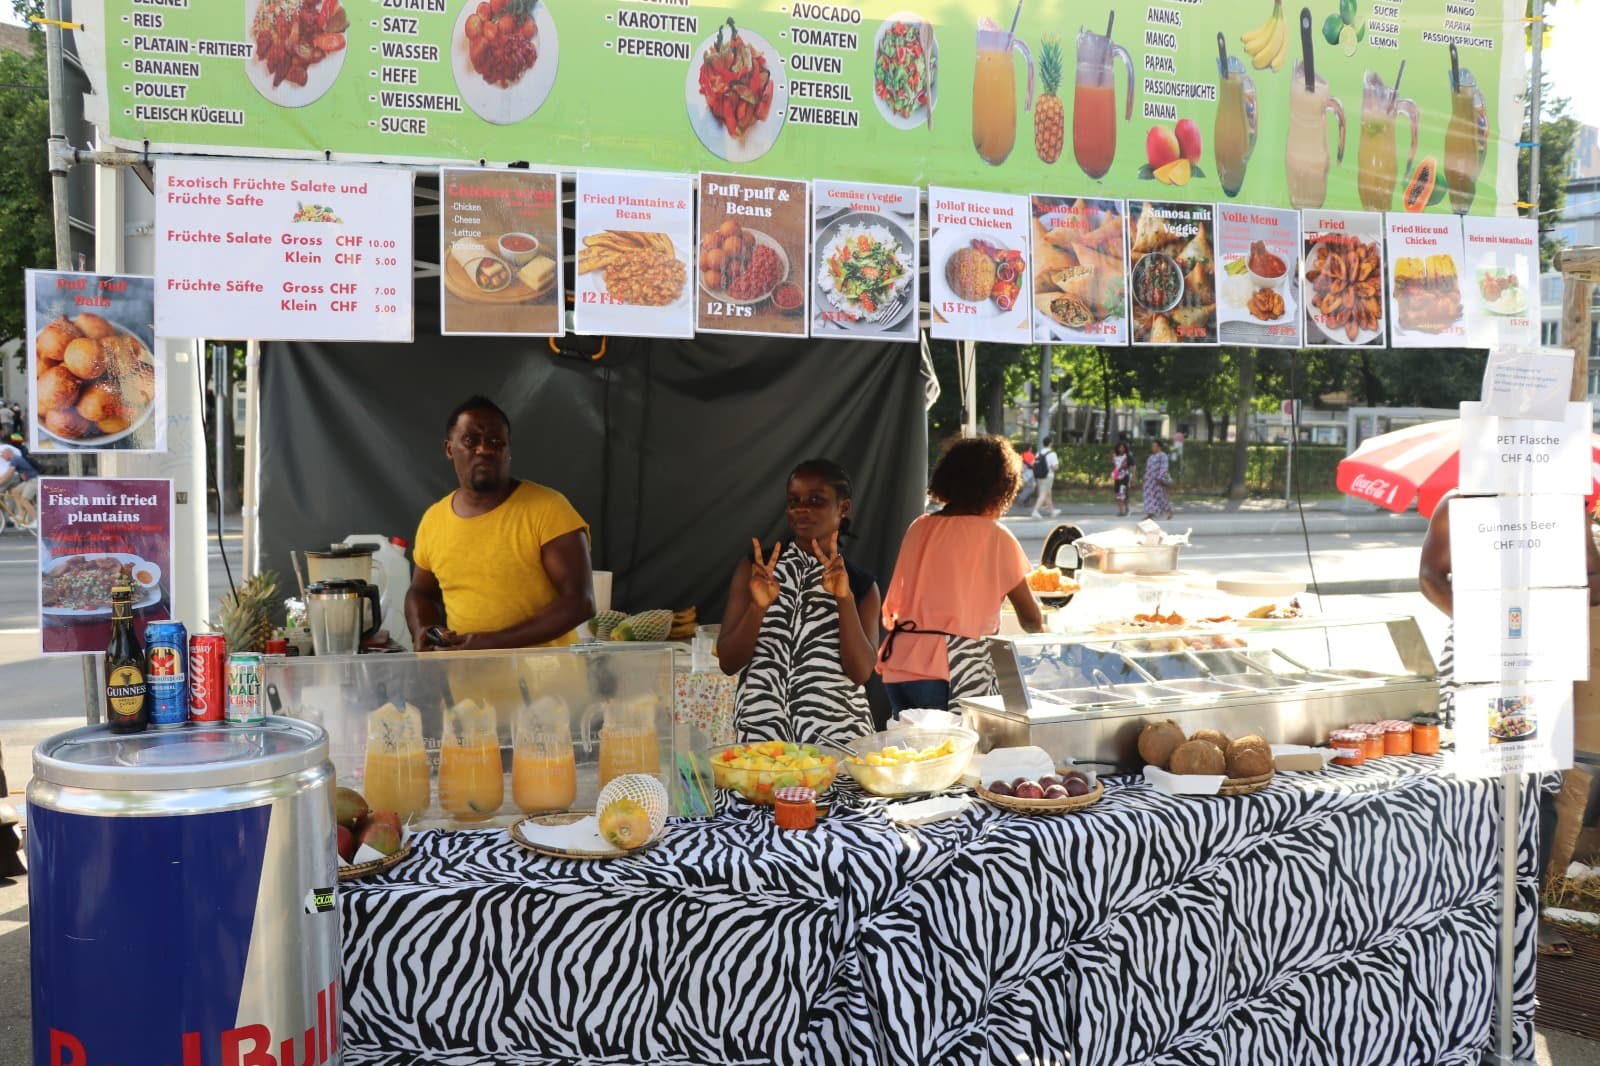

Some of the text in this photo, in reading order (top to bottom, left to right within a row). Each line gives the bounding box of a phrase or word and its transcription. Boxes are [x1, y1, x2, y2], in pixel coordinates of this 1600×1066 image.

[792, 4, 861, 23] AVOCADO
[1148, 8, 1181, 26] ANANAS,
[1374, 6, 1398, 17] SUCRE
[1447, 5, 1475, 16] MANGO
[134, 14, 162, 28] REIS
[383, 18, 417, 34] SATZ
[618, 11, 697, 33] KAROTTEN
[1369, 20, 1399, 33] WASSER
[1444, 20, 1471, 32] PAPAYA
[792, 28, 857, 49] TOMATEN
[1146, 32, 1177, 49] MANGO,
[1370, 36, 1398, 48] LEMON
[134, 37, 188, 53] PLATAIN
[198, 41, 253, 57] FRITIERT
[382, 43, 438, 61] WASSER
[618, 38, 690, 60] PEPERONI
[135, 61, 199, 76] BANANEN
[791, 55, 841, 74] OLIVEN
[1145, 56, 1175, 74] PAPAYA,
[382, 69, 417, 84] HEFE
[135, 84, 186, 99] POULET
[791, 81, 851, 101] PETERSIL
[381, 94, 462, 111] WEISSMEHL
[135, 106, 244, 125] FLEISCH KÜGELLI
[790, 107, 858, 127] ZWIEBELN
[1144, 103, 1176, 119] BANANA
[381, 119, 426, 134] SUCRE
[168, 176, 367, 194] Exotisch Früchte Salate und
[708, 183, 790, 201] Puff-puff &
[168, 192, 264, 207] Früchte Safte
[583, 194, 686, 209] Fried Plantains &
[616, 209, 652, 220] Beans
[726, 202, 772, 217] Beans
[936, 200, 1014, 216] Jollof Rice und
[1148, 208, 1212, 220] Samosa mit
[938, 214, 1012, 230] Fried Chicken
[1320, 219, 1345, 230] Fried
[1392, 225, 1414, 234] Fried
[1433, 226, 1448, 234] und
[1163, 224, 1199, 237] Veggie
[167, 231, 395, 248] Früchte Salate Gross CHF 10.00
[1406, 236, 1437, 246] Chicken
[285, 252, 396, 266] Klein CHF 5.00
[167, 279, 396, 296] Früchte Säfte Gross CHF 7.00
[582, 291, 596, 304] 12
[281, 300, 396, 313] Klein CHF 5.00
[706, 303, 752, 318] 12 Frs
[942, 302, 977, 314] 13 Frs
[1497, 434, 1560, 446] PET Flasche
[1501, 454, 1550, 463] CHF 4.00
[49, 494, 158, 506] Fisch mit fried
[68, 510, 140, 525] plantains
[1478, 520, 1556, 533] Guinness Beer
[1494, 540, 1515, 550] CHF
[230, 673, 260, 684] VITA
[106, 686, 146, 698] GUINNESS
[228, 685, 260, 696] MALT
